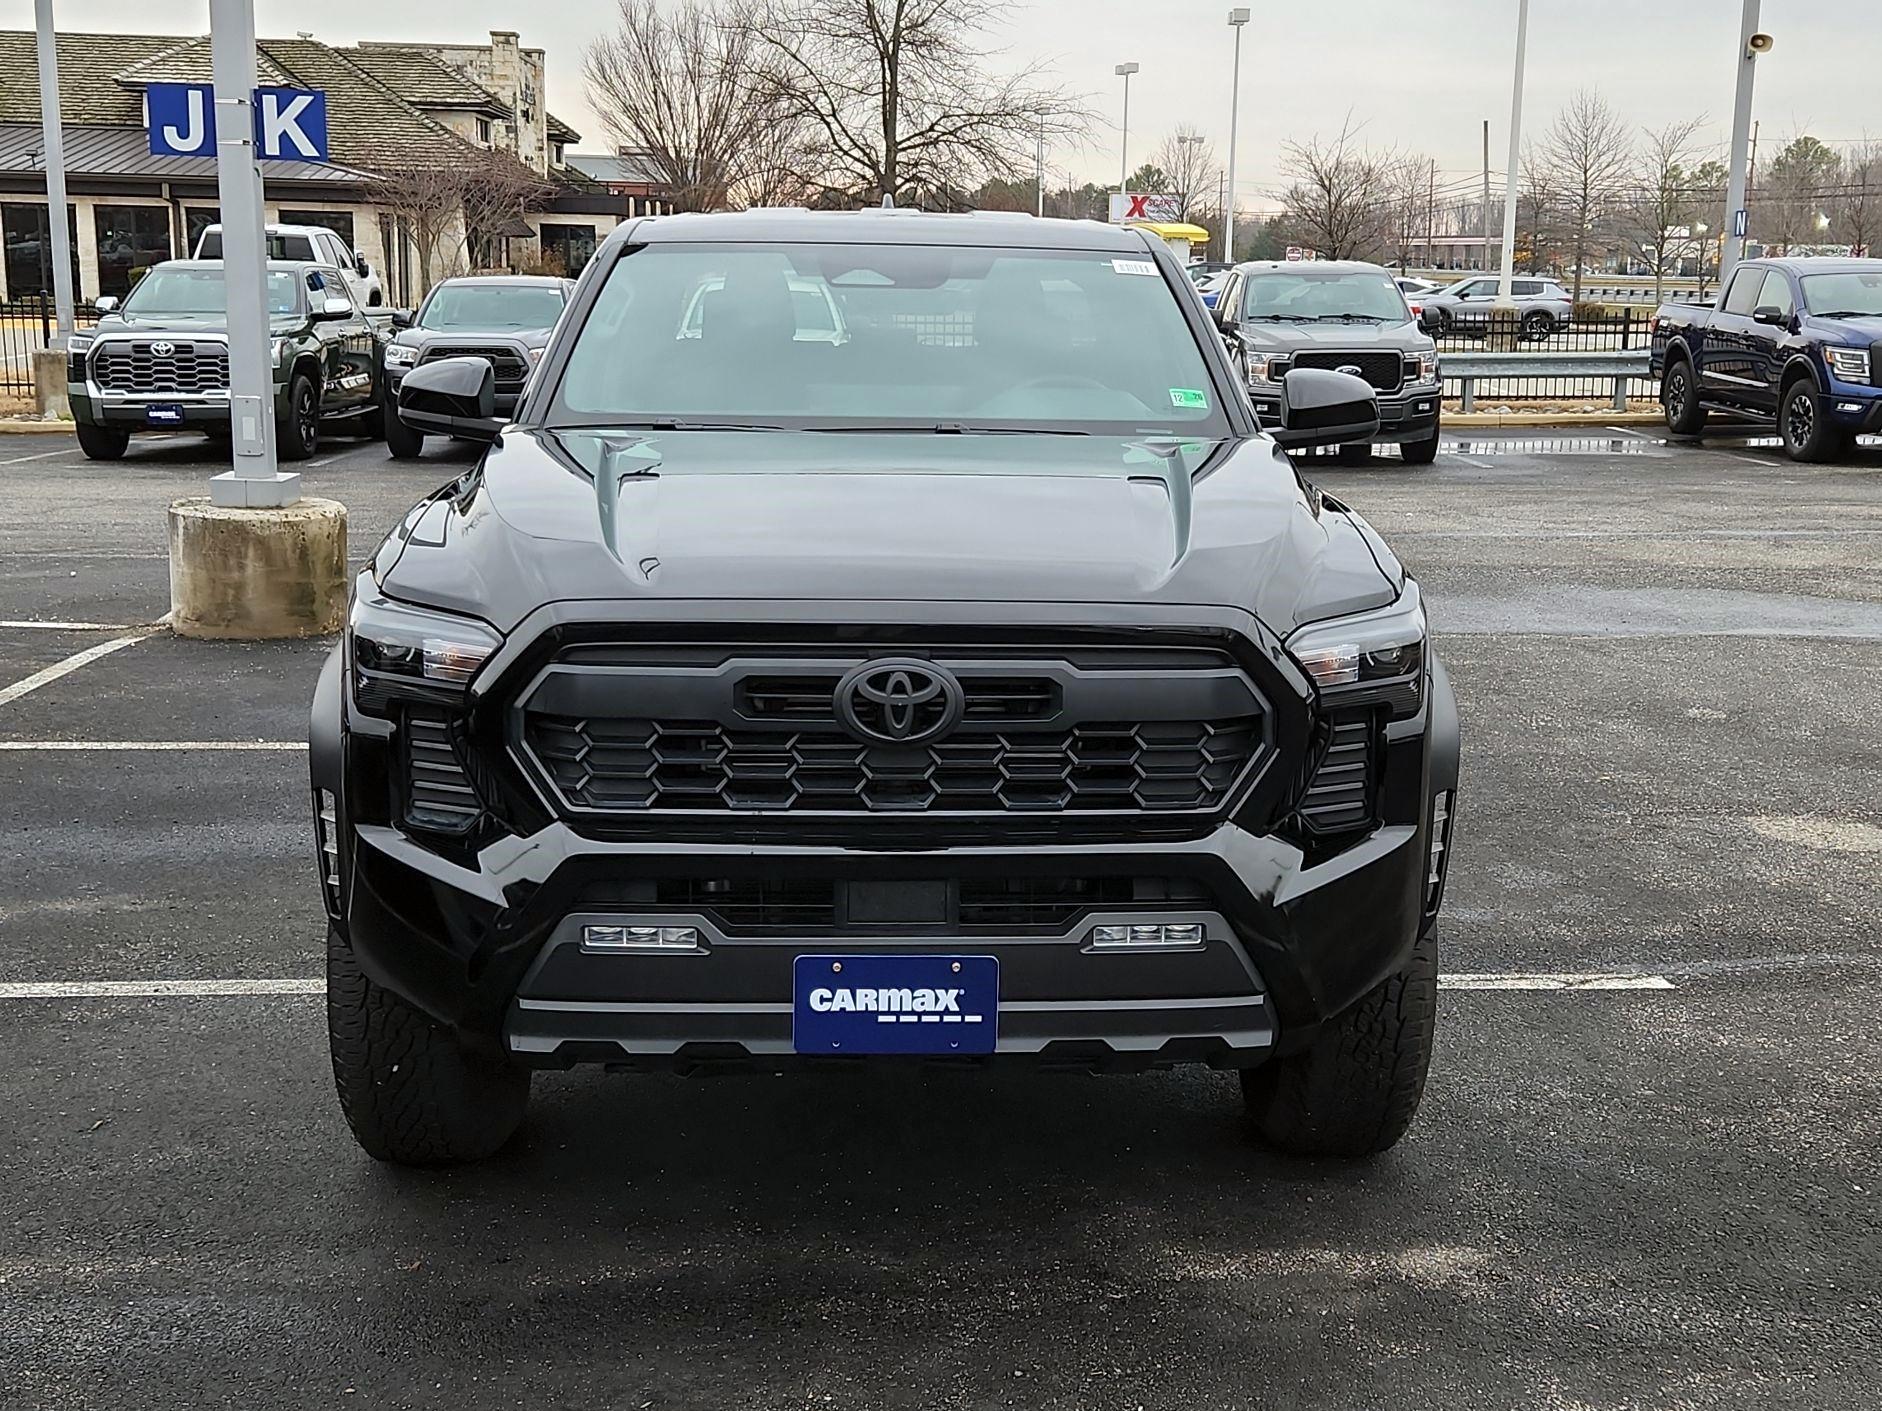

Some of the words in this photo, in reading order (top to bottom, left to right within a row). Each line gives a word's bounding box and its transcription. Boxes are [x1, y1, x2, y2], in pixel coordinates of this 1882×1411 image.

[163, 89, 205, 152] J
[261, 94, 321, 157] K
[1735, 211, 1747, 236] N
